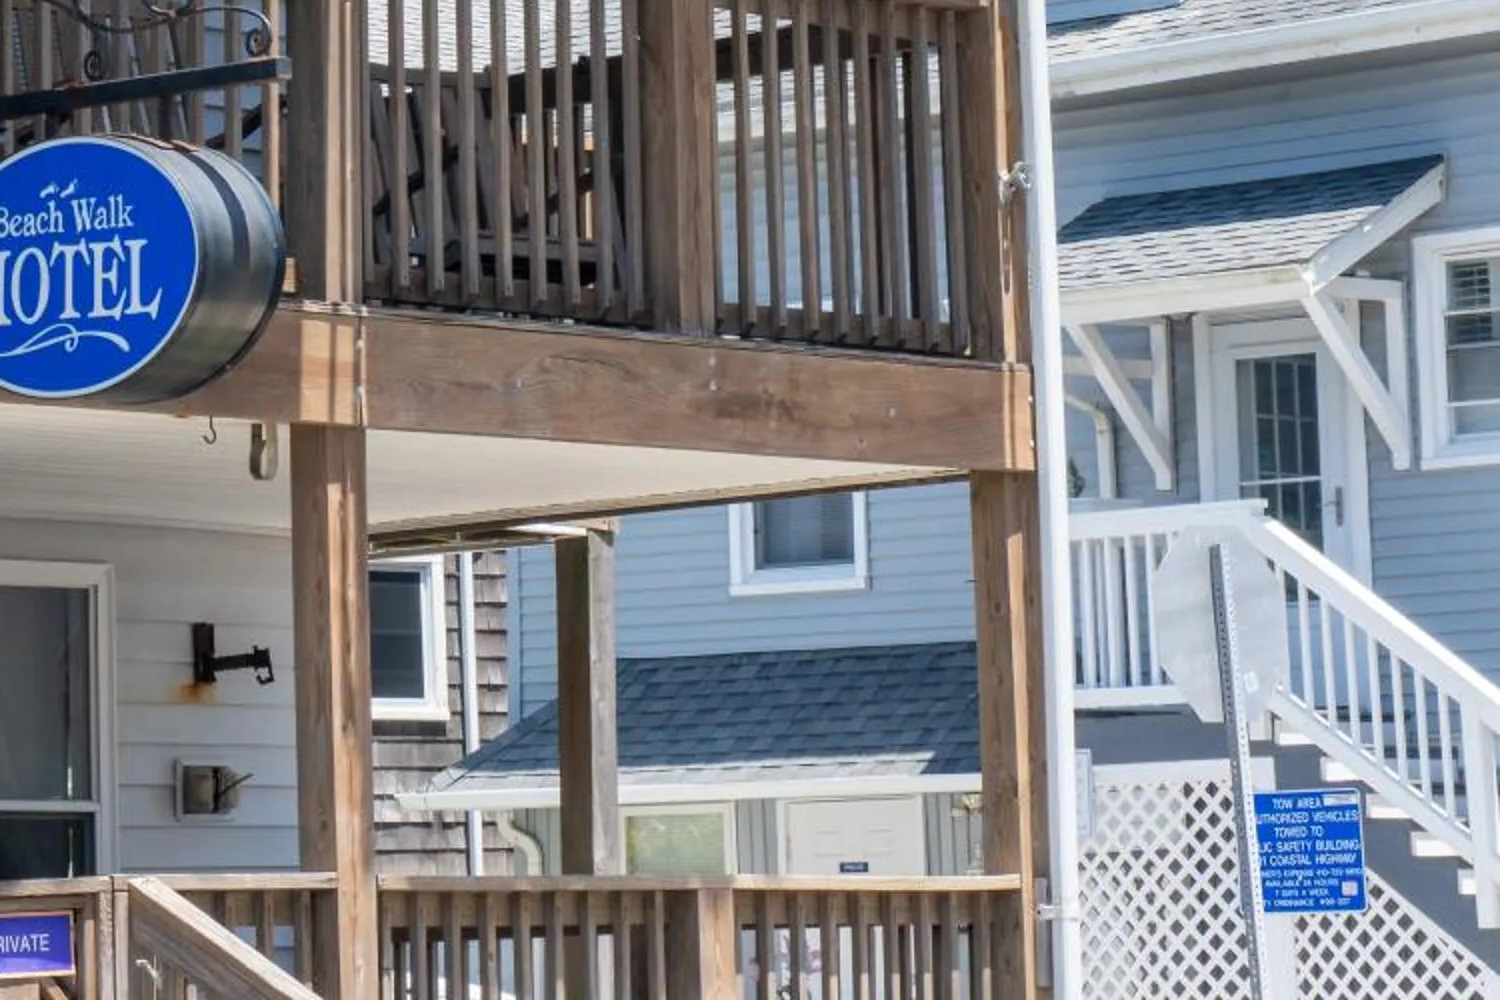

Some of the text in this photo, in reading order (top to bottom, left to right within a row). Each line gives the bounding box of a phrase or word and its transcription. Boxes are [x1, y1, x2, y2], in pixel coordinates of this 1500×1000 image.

[72, 195, 134, 234] Walk
[1272, 797, 1322, 809] TOW AREA
[1312, 809, 1359, 822] VEHICLES
[1275, 824, 1324, 838] TOWED TO
[1276, 840, 1313, 853] SAFETY
[1316, 839, 1361, 851] BUILDING
[1270, 854, 1312, 867] COASTAL
[1316, 852, 1357, 865] HIGHWAY
